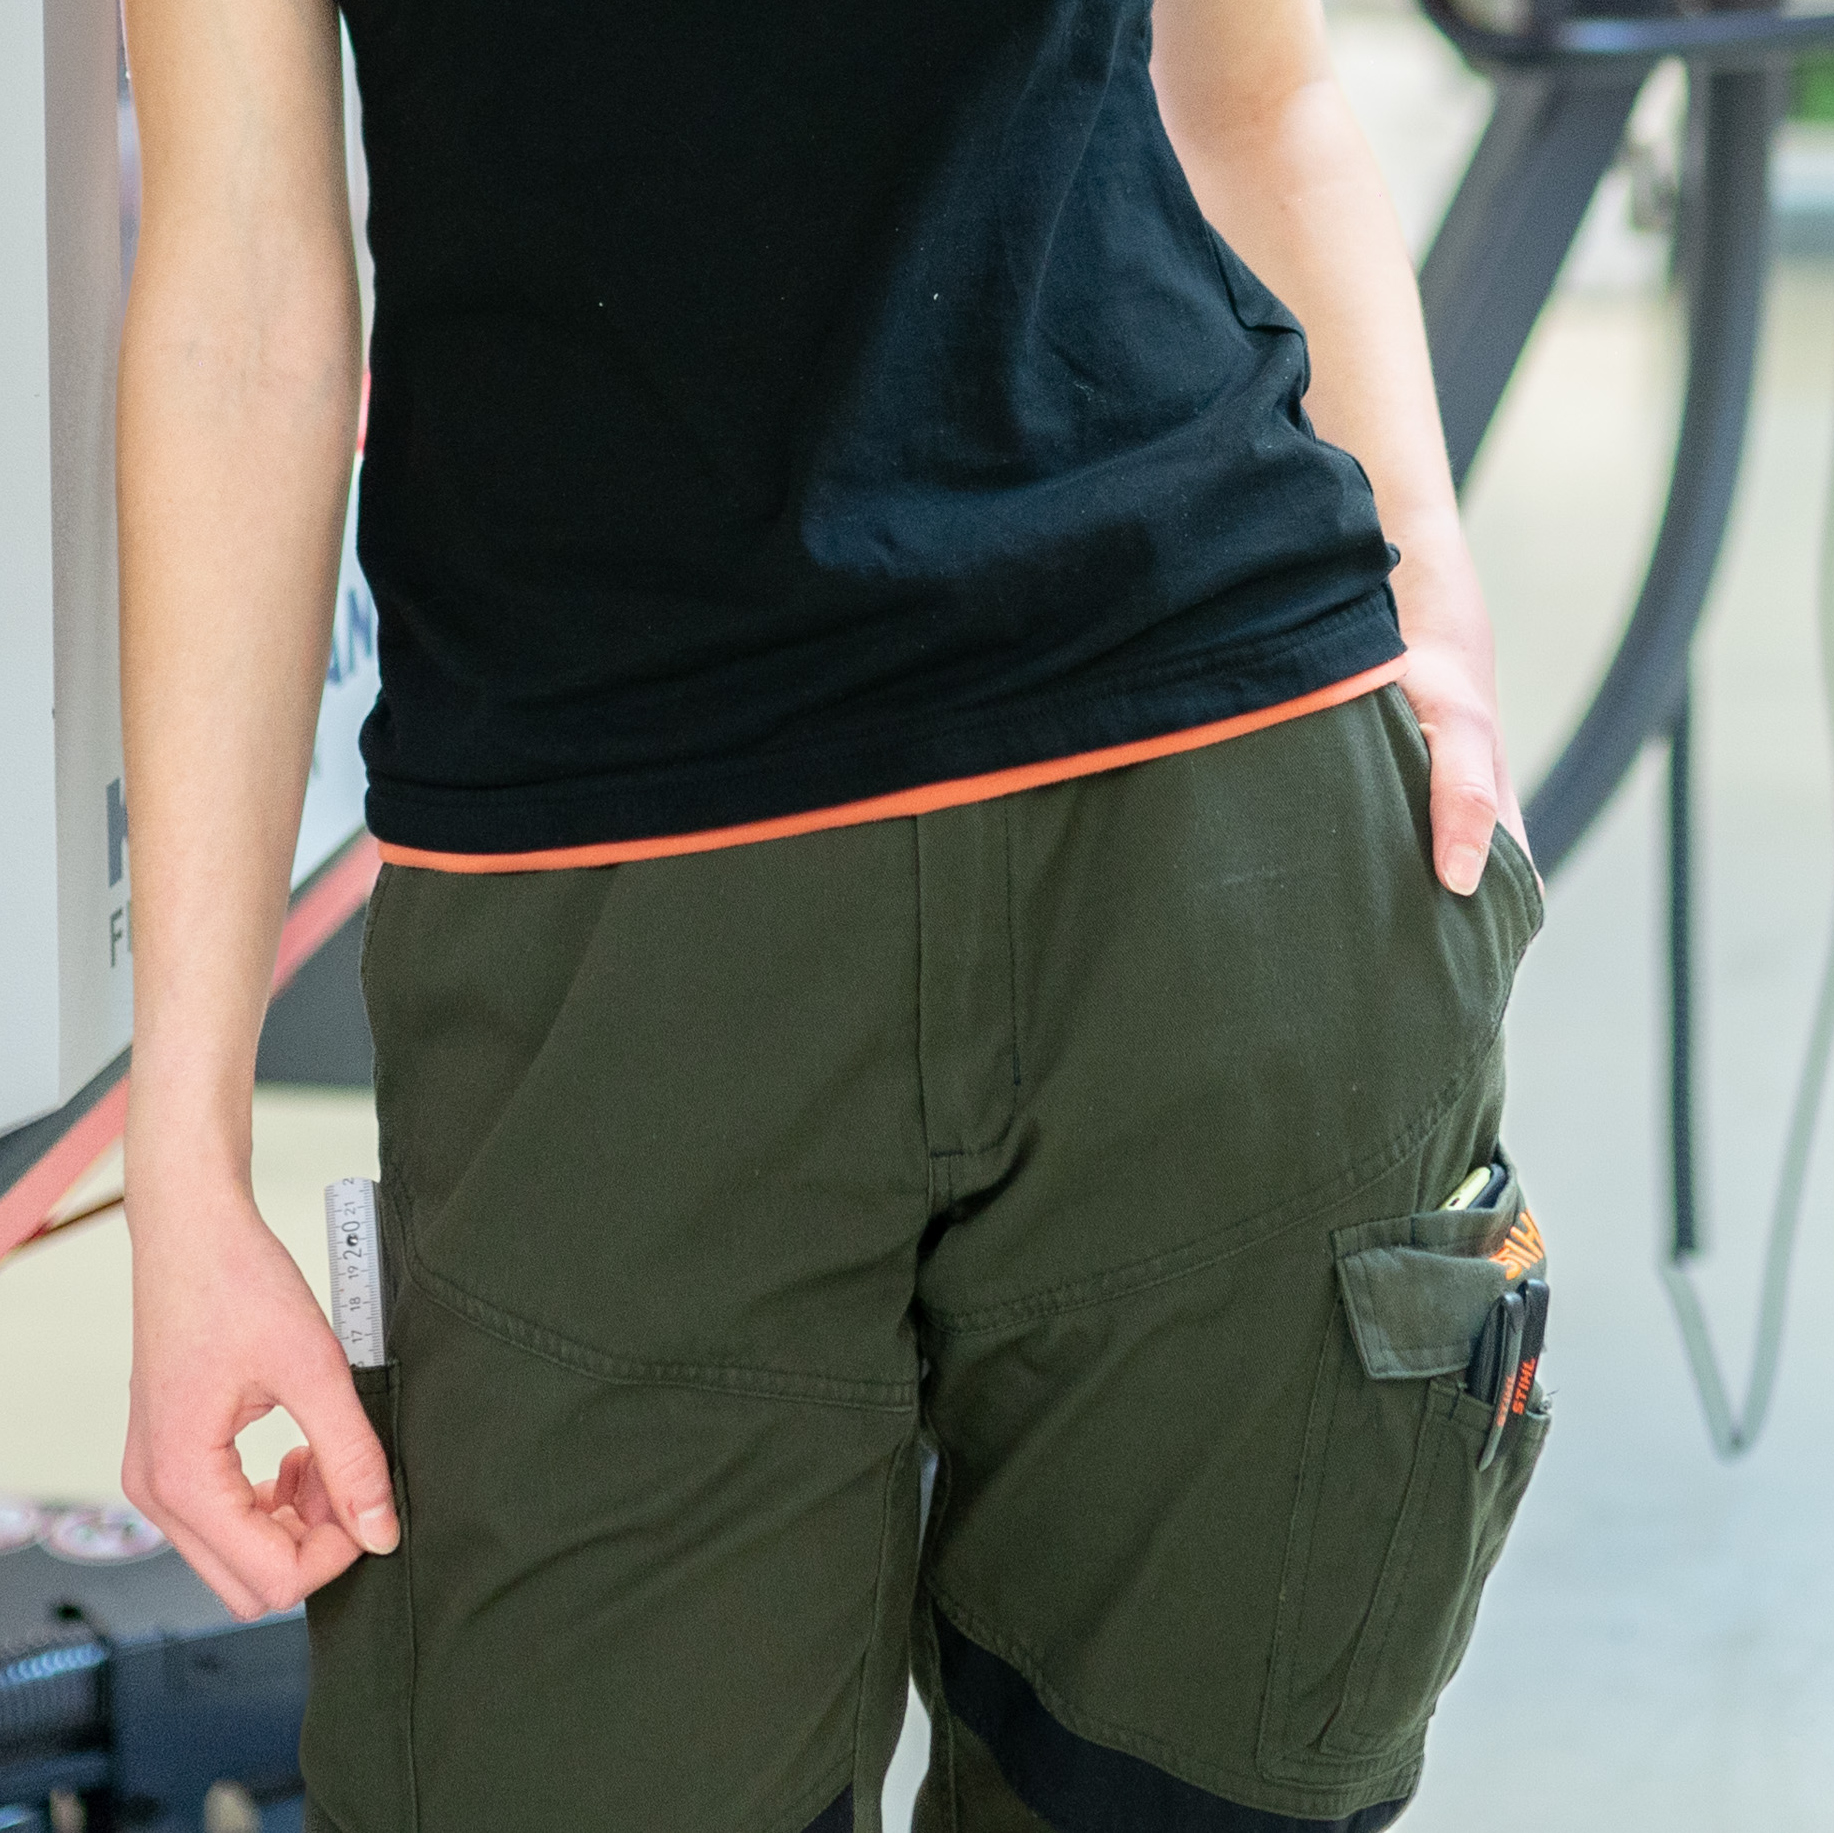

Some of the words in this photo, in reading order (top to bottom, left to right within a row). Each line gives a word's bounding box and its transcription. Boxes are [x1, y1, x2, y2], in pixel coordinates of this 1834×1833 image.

[343, 1201, 357, 1216] 21
[347, 1266, 360, 1280] 19
[349, 1296, 361, 1312] 18
[350, 1330, 363, 1344] 17
[1512, 1355, 1537, 1415] STIHL
